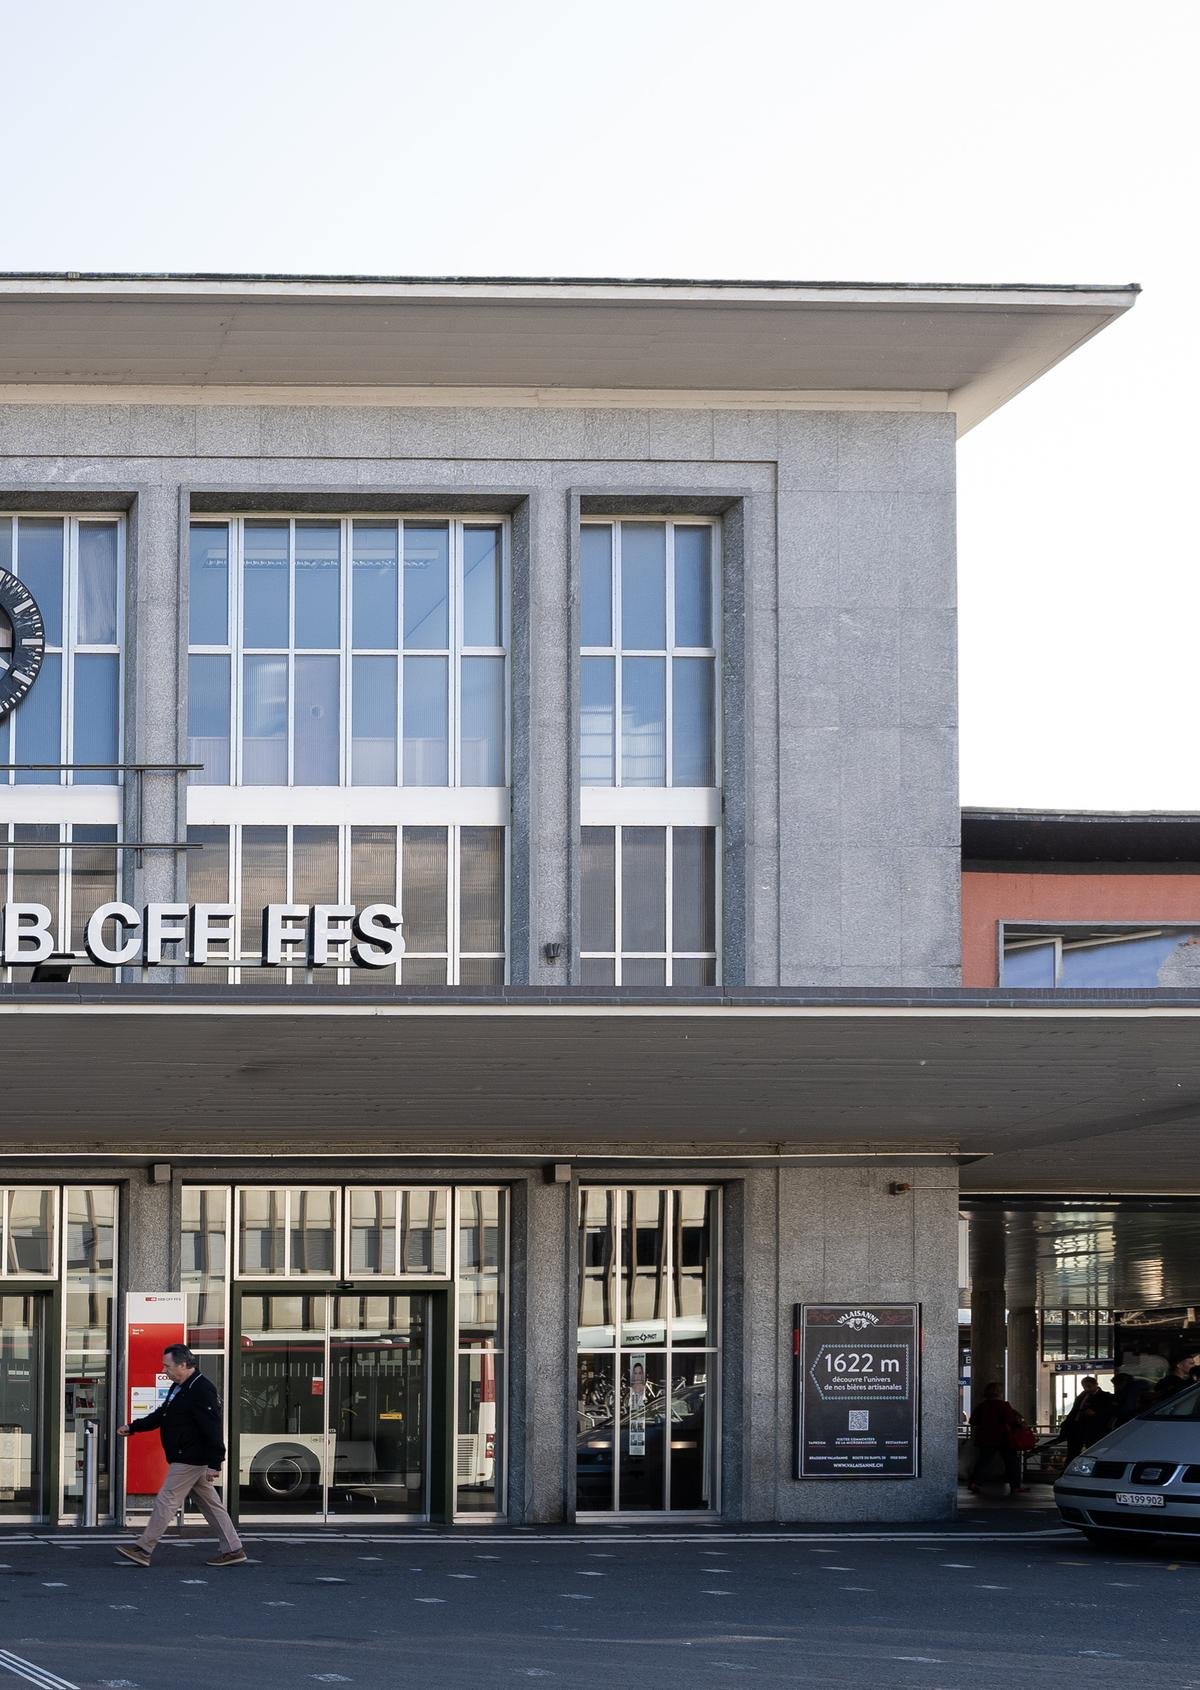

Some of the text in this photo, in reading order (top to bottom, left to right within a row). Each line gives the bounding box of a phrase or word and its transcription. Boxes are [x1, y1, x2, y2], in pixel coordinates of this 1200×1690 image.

[84, 901, 236, 966] CFF
[264, 903, 406, 969] FFS
[836, 1310, 880, 1325] VALAISANNE
[824, 1353, 900, 1373] 1622 m
[831, 1375, 891, 1383] découvre l'univers
[846, 1383, 867, 1391] bières
[867, 1383, 902, 1391] artisanales
